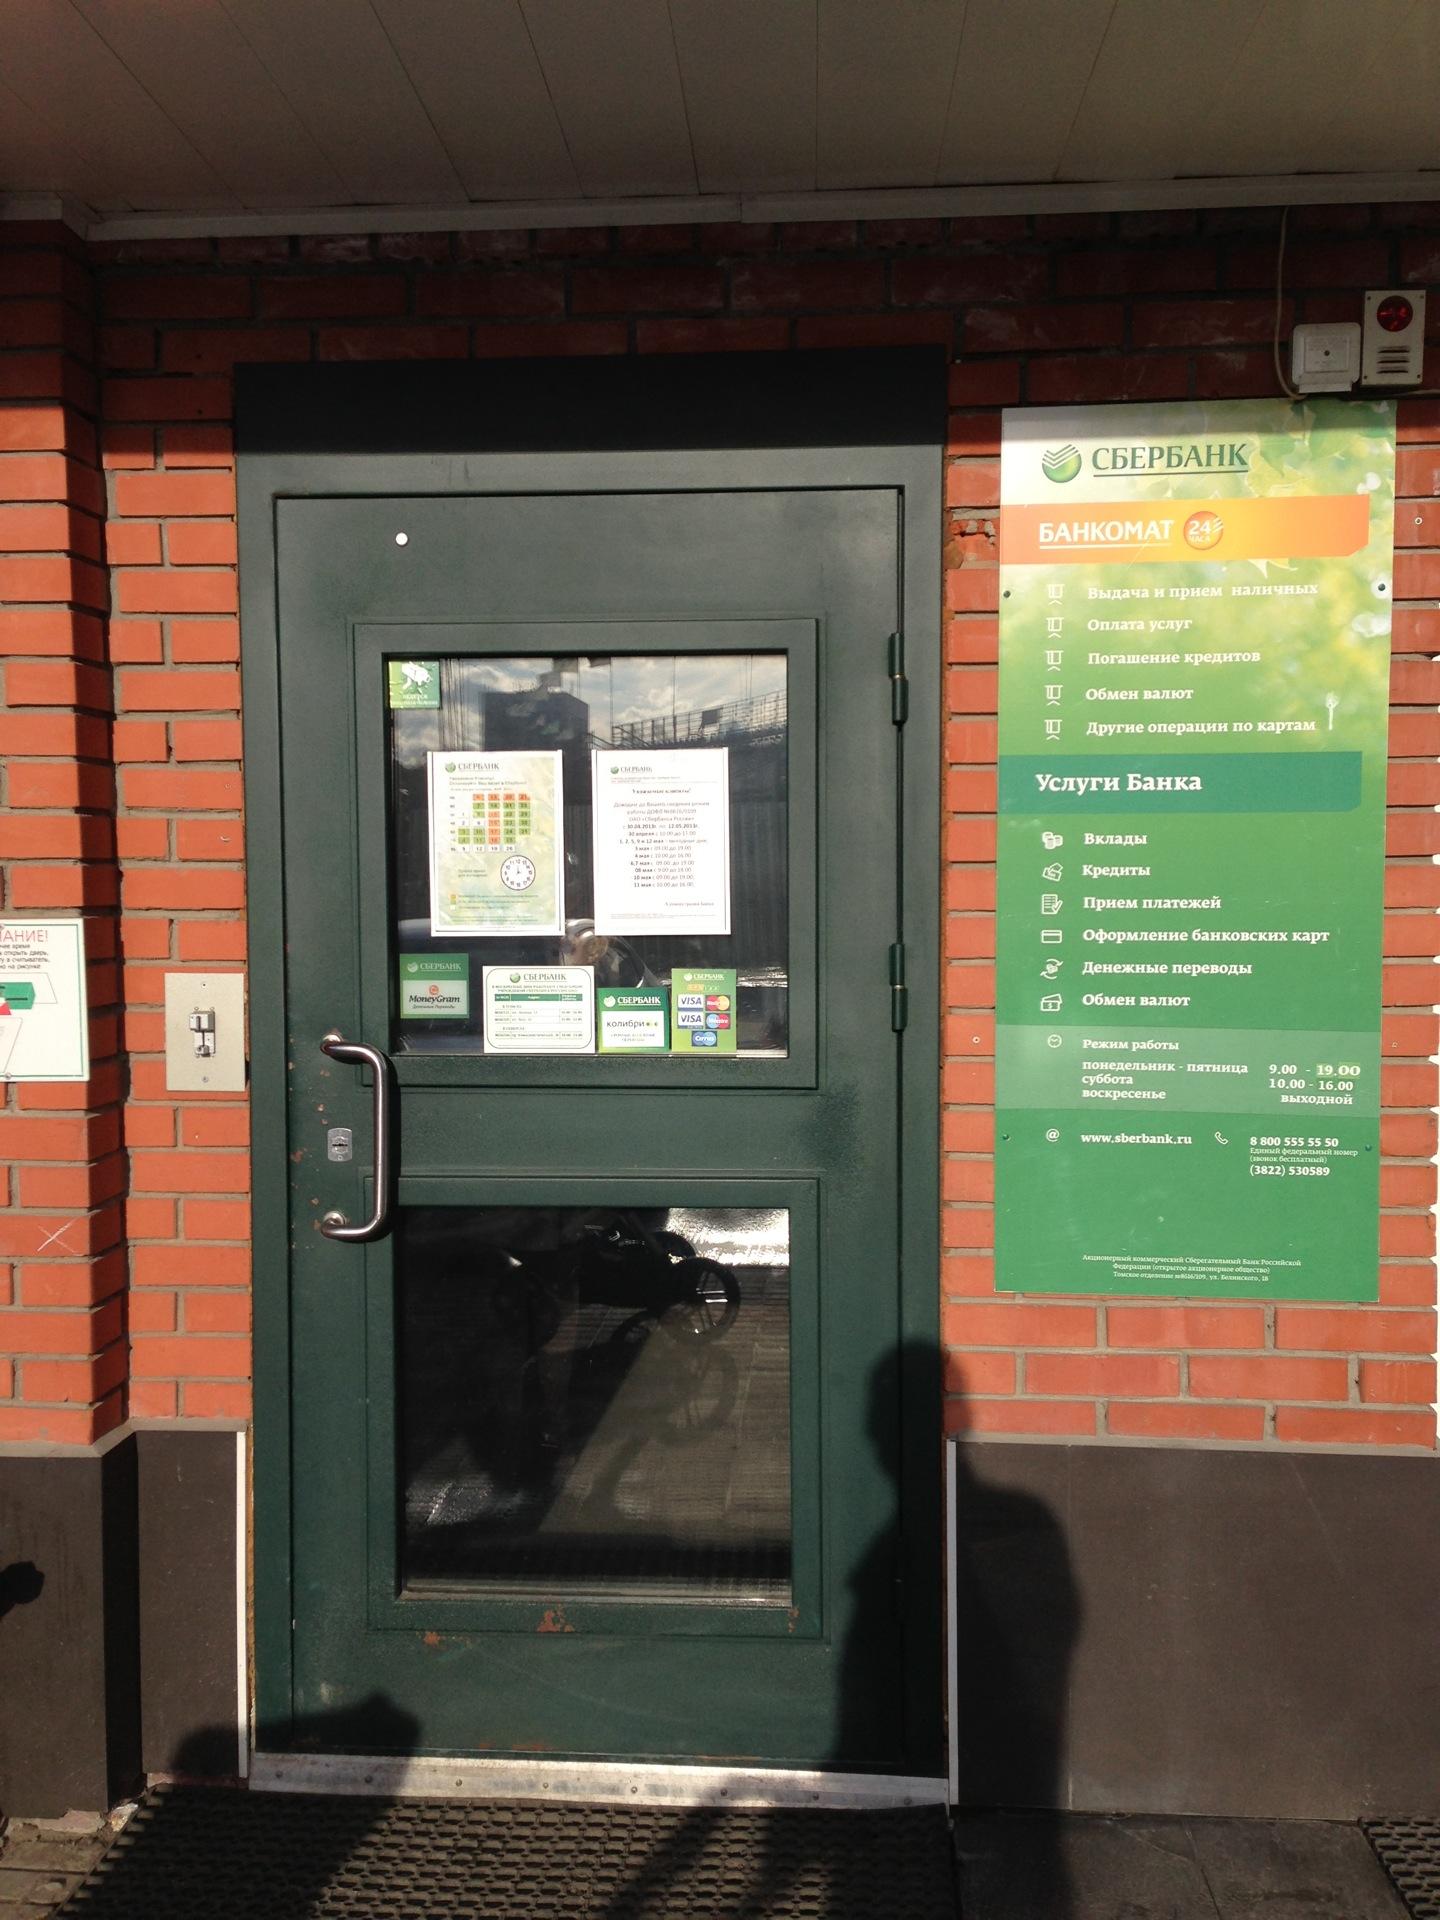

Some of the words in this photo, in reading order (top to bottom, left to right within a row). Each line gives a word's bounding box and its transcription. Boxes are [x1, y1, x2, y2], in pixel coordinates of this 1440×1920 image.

[1092, 443, 1248, 471] СБЕРБАНК
[1039, 520, 1174, 544] БАНКОМАТ
[1189, 521, 1211, 535] 24
[1088, 585, 1149, 600] Выдача
[1154, 587, 1164, 597] и
[1169, 586, 1222, 599] прием
[1232, 583, 1318, 596] наличных
[1088, 618, 1144, 631] Оплата
[1149, 618, 1192, 633] услуг
[1088, 652, 1180, 665] Погашение
[1184, 651, 1261, 666] кредитов
[1086, 687, 1138, 700] Обмен
[1143, 688, 1193, 700] валют
[1087, 720, 1143, 737] Другие
[1148, 721, 1228, 735] операции
[1233, 721, 1253, 732] по
[1257, 720, 1316, 734] картам
[1035, 773, 1119, 795] Услуги
[1127, 773, 1202, 791] Банка
[1084, 833, 1147, 846] Вклады
[1082, 864, 1151, 878] Кредиты
[1083, 896, 1137, 911] Прием
[1142, 895, 1221, 910] платежей
[0, 930, 48, 942] АНИЕ!
[1083, 928, 1188, 945] Оформление
[1192, 928, 1287, 943] банковских
[1292, 930, 1329, 944] карт
[1082, 961, 1168, 975] Денежные
[1172, 962, 1252, 976] переводы
[409, 994, 460, 1003] MoneyGram
[1082, 993, 1136, 1007] Обмен
[1141, 994, 1190, 1006] валют
[607, 1020, 644, 1029] колибри
[1083, 1039, 1128, 1050] Режим
[1132, 1038, 1179, 1052] работы
[1082, 1060, 1175, 1073] понедельник
[1187, 1062, 1248, 1074] пятница
[1269, 1064, 1297, 1075] 9.00
[1317, 1065, 1361, 1077] 19.00
[1082, 1073, 1133, 1087] суббота
[1269, 1079, 1305, 1090] 10.00
[1319, 1081, 1353, 1092] 16.00
[1082, 1088, 1166, 1100] воскресенье
[1281, 1093, 1353, 1106] выходной
[1081, 1132, 1192, 1145] www.sberbank.ru
[1250, 1137, 1257, 1145] 8
[1260, 1137, 1280, 1146] 800
[1284, 1138, 1304, 1146] 555
[1308, 1138, 1321, 1146] 55
[1325, 1138, 1338, 1147] 50
[1282, 1148, 1332, 1156] федеральный
[1250, 1165, 1285, 1176] (3822)
[1289, 1167, 1330, 1176] 530589
[1133, 1257, 1183, 1265] коммерческий
[1185, 1257, 1241, 1265] Сберегательный
[1113, 1263, 1151, 1271] Федерации
[1153, 1264, 1186, 1272] (открытое
[1235, 1266, 1270, 1274] общество)
